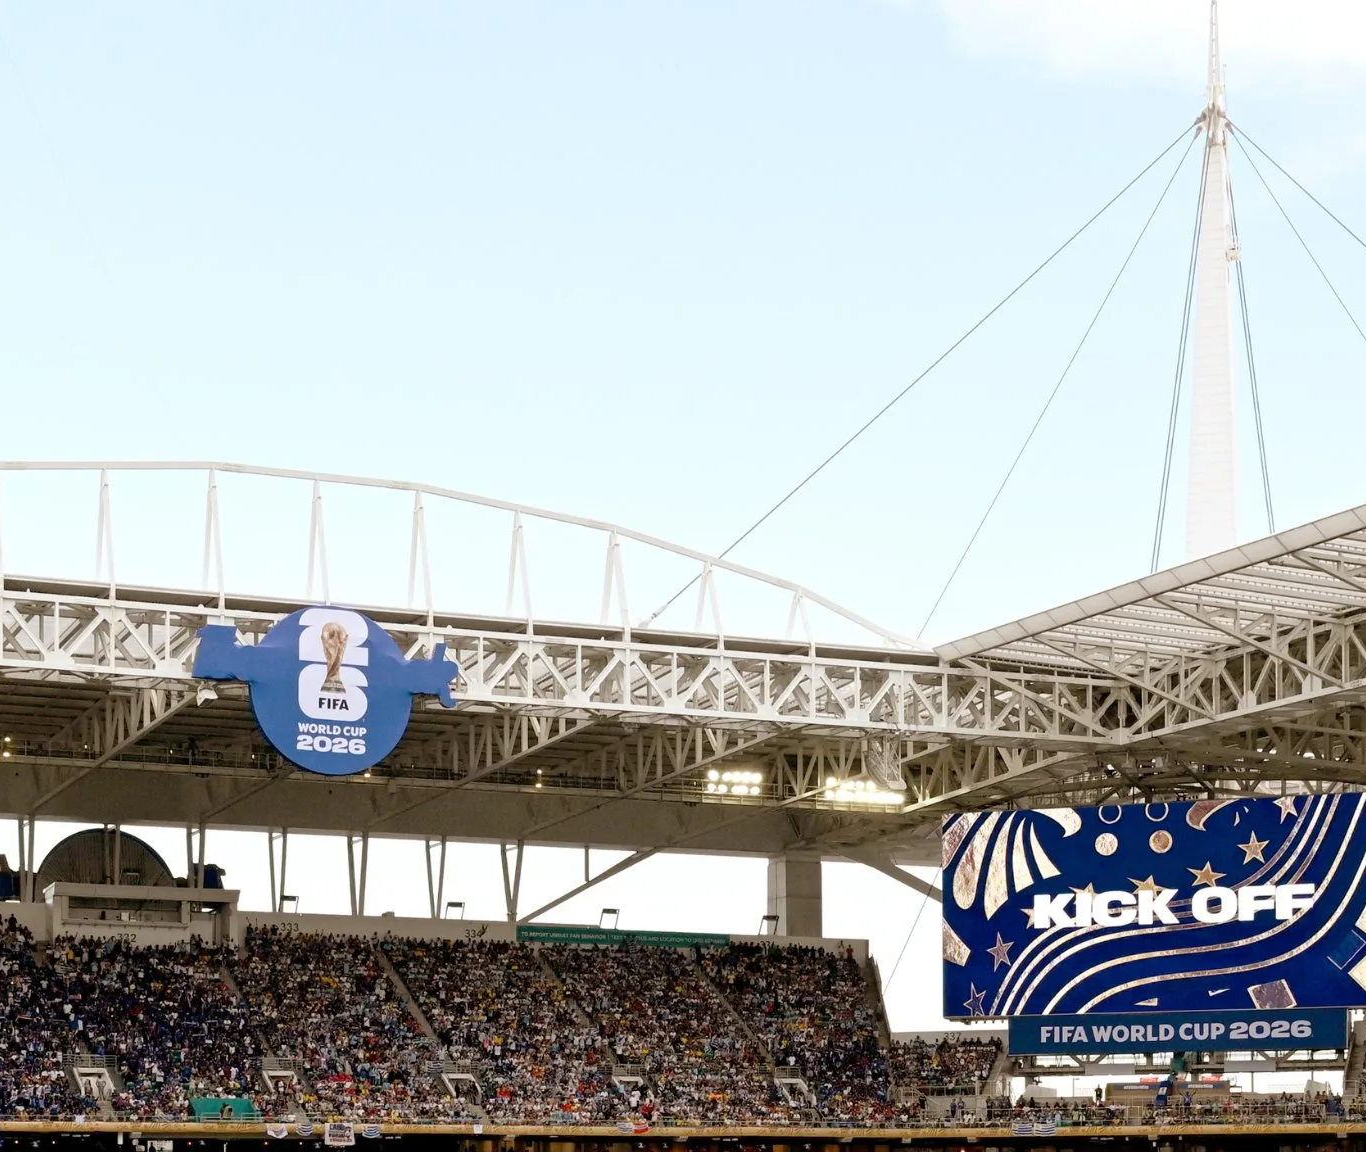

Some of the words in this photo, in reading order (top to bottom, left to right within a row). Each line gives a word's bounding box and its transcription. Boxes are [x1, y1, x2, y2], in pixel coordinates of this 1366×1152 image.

[318, 697, 349, 711] FIFA
[298, 722, 341, 735] WORLD
[343, 726, 367, 737] CUP
[296, 734, 367, 755] 2026
[1033, 888, 1179, 929] KICK
[1191, 883, 1315, 923] OFF
[281, 922, 299, 932] 333
[1040, 1025, 1088, 1043] FIFA
[1091, 1023, 1174, 1043] WORLD
[1179, 1022, 1225, 1041] CUP
[1229, 1020, 1313, 1039] 2026
